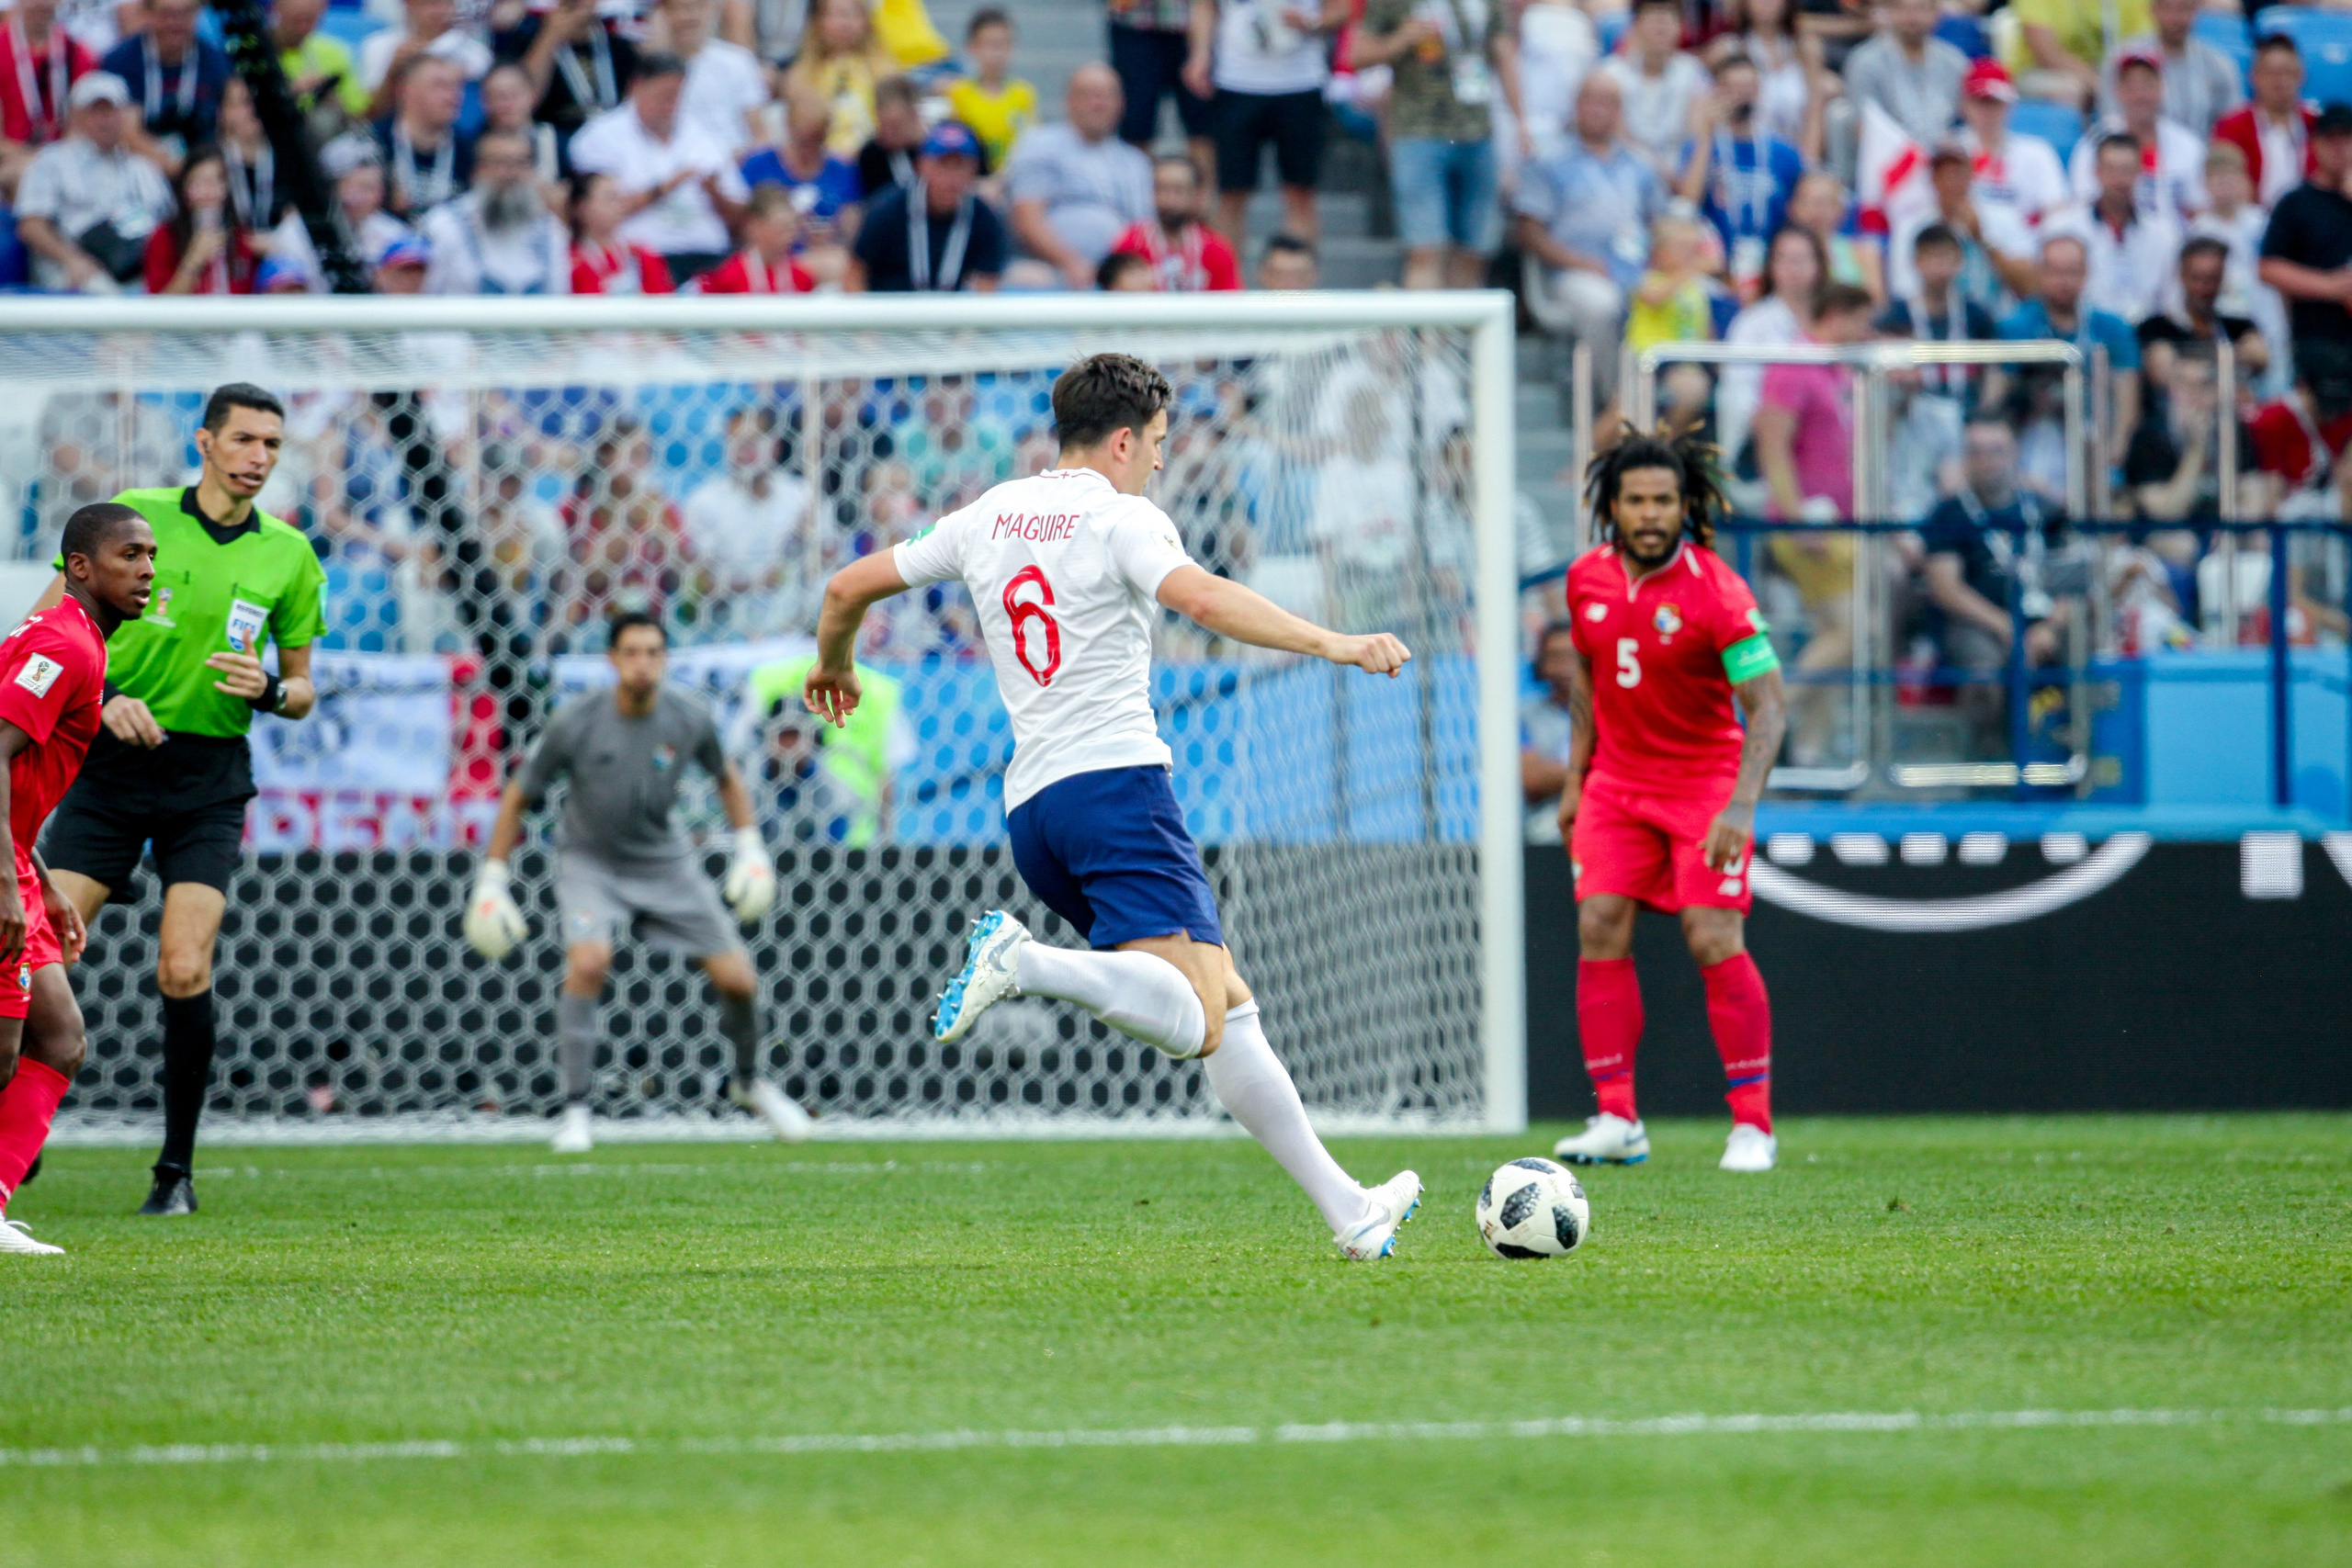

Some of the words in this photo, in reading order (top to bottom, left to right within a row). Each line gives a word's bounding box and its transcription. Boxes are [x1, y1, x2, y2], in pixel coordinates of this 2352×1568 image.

[991, 513, 1080, 543] MAGUIRE
[1002, 564, 1061, 687] 6
[1615, 637, 1642, 689] 5
